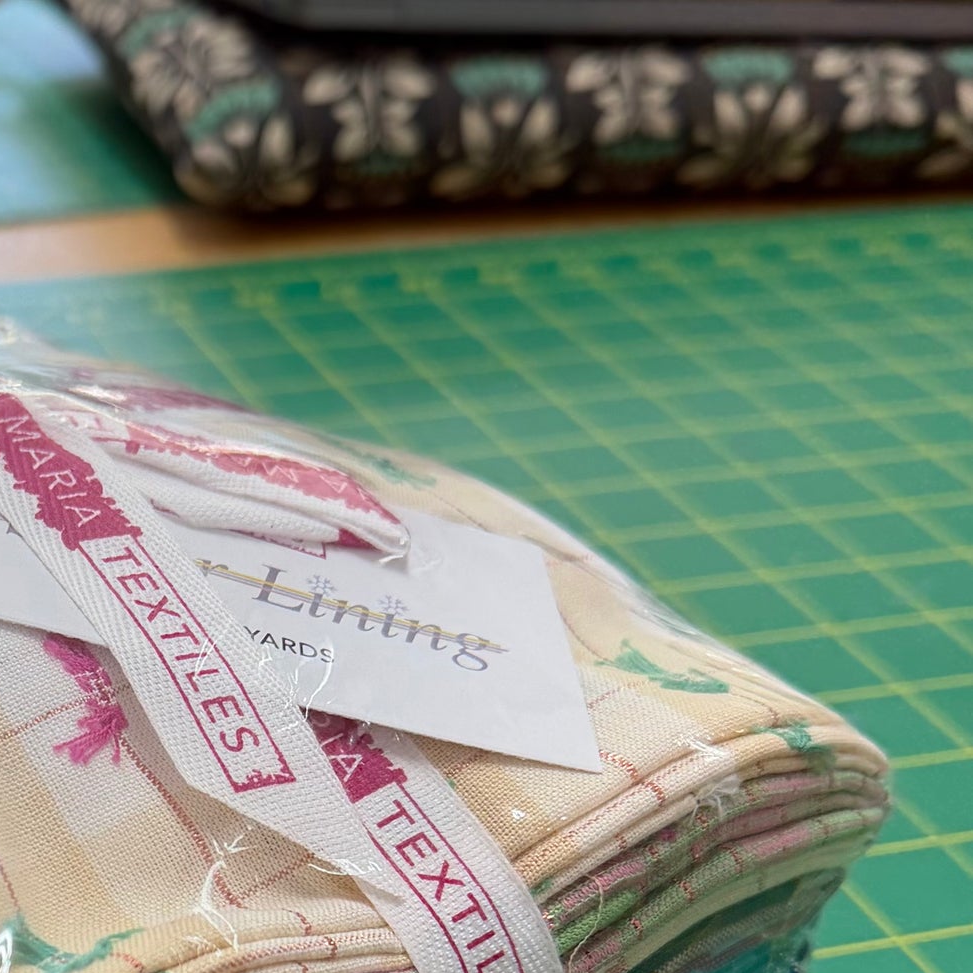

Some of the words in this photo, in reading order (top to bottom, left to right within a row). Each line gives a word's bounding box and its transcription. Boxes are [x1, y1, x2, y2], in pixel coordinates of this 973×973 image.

[102, 546, 260, 753] TEXTILES
[242, 625, 335, 664] YARDS
[251, 563, 490, 672] Lining
